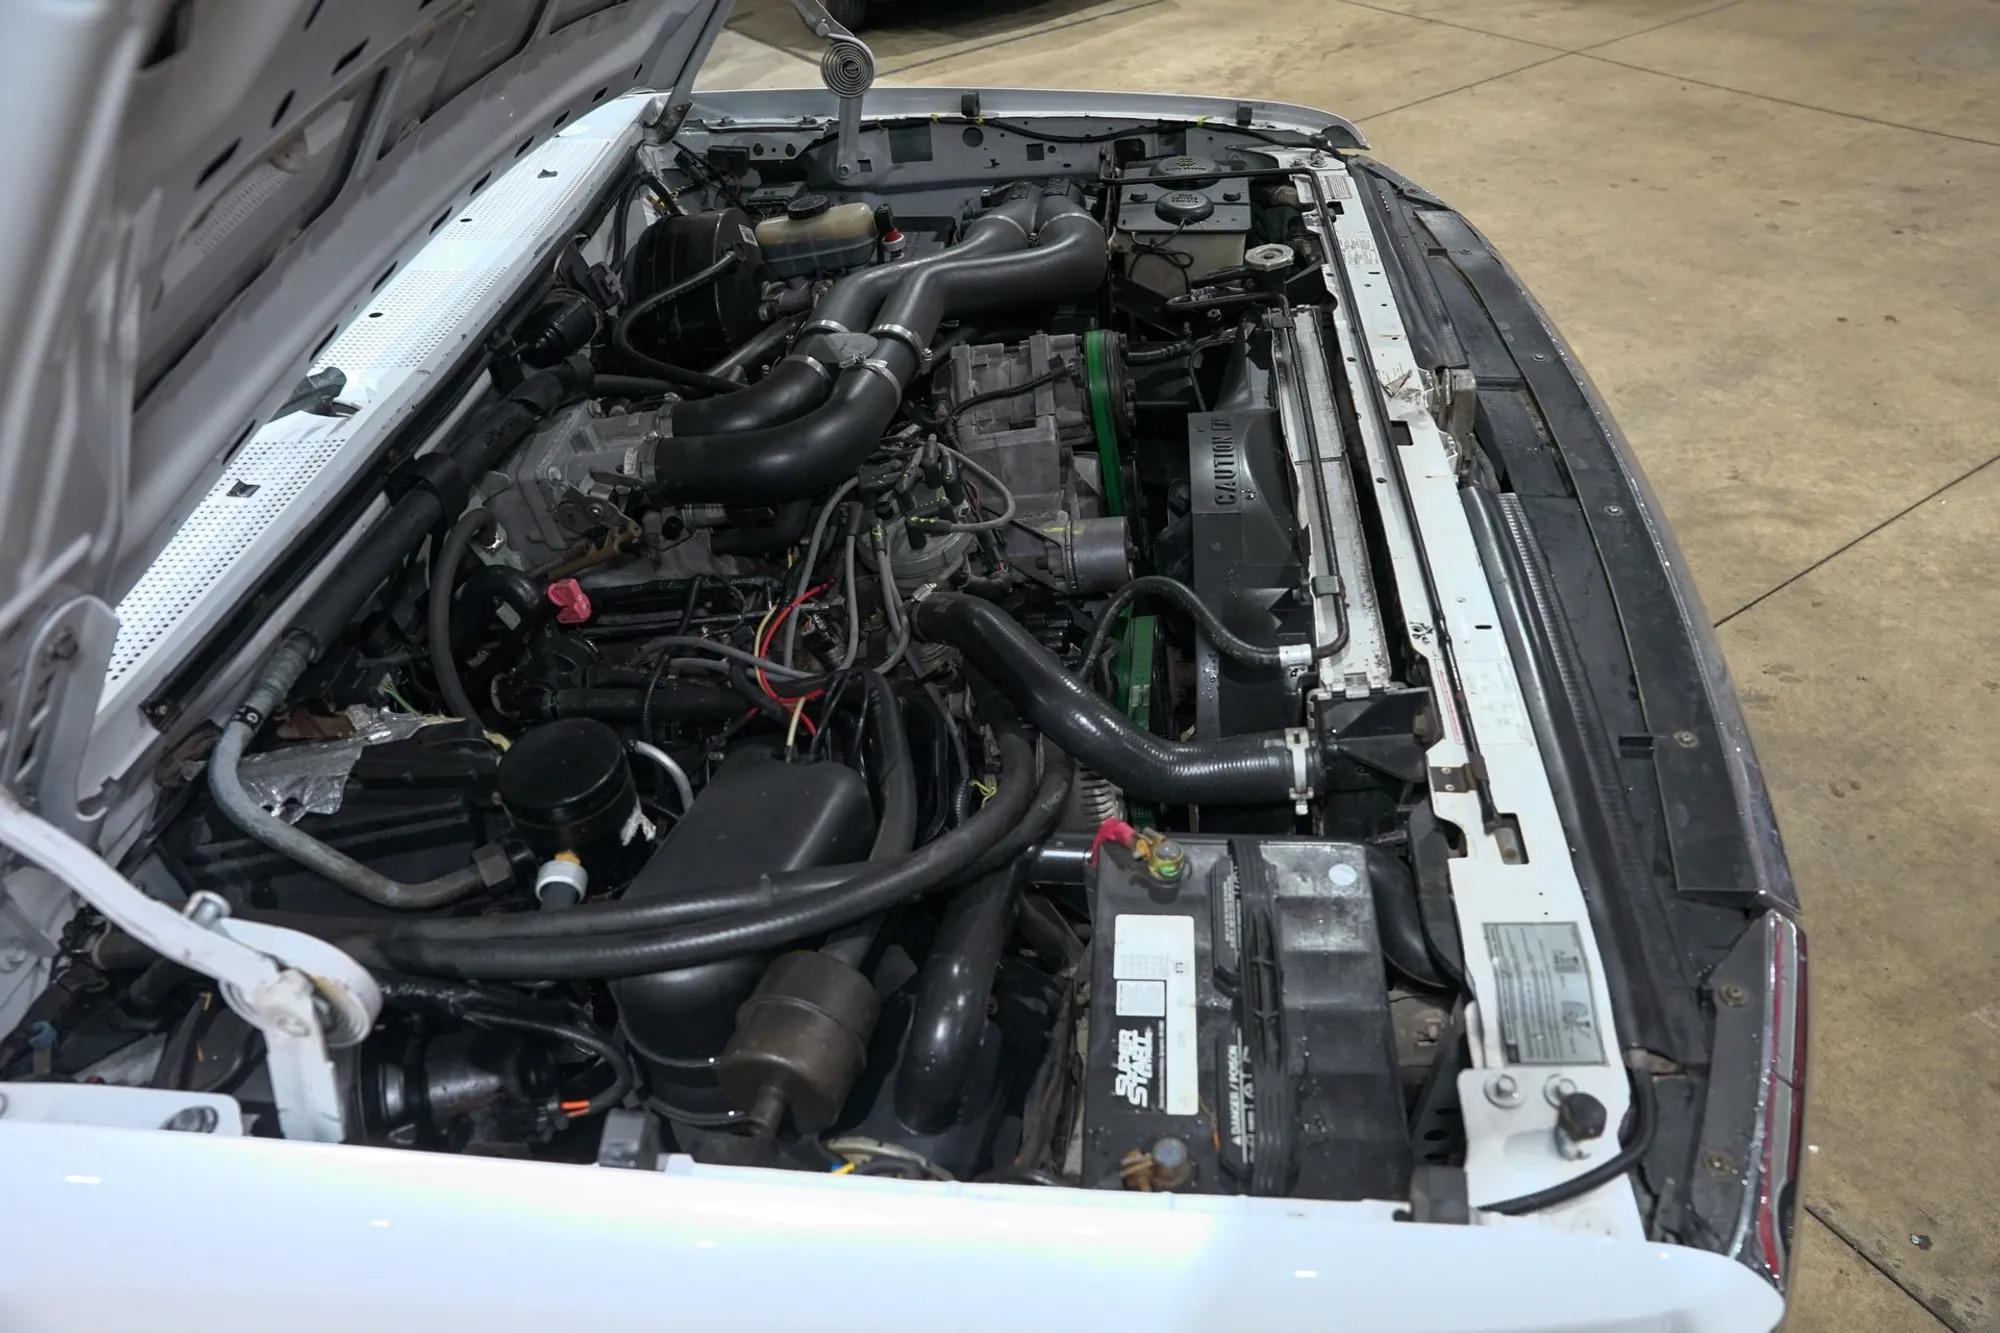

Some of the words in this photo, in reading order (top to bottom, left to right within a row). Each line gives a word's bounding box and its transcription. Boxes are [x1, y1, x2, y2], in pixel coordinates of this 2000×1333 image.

[1212, 436, 1237, 505] CAUTION
[1115, 1029, 1138, 1096] SUPER
[1128, 1027, 1153, 1108] START
[1228, 1044, 1240, 1083] POISON
[1229, 1091, 1241, 1136] DANGER
